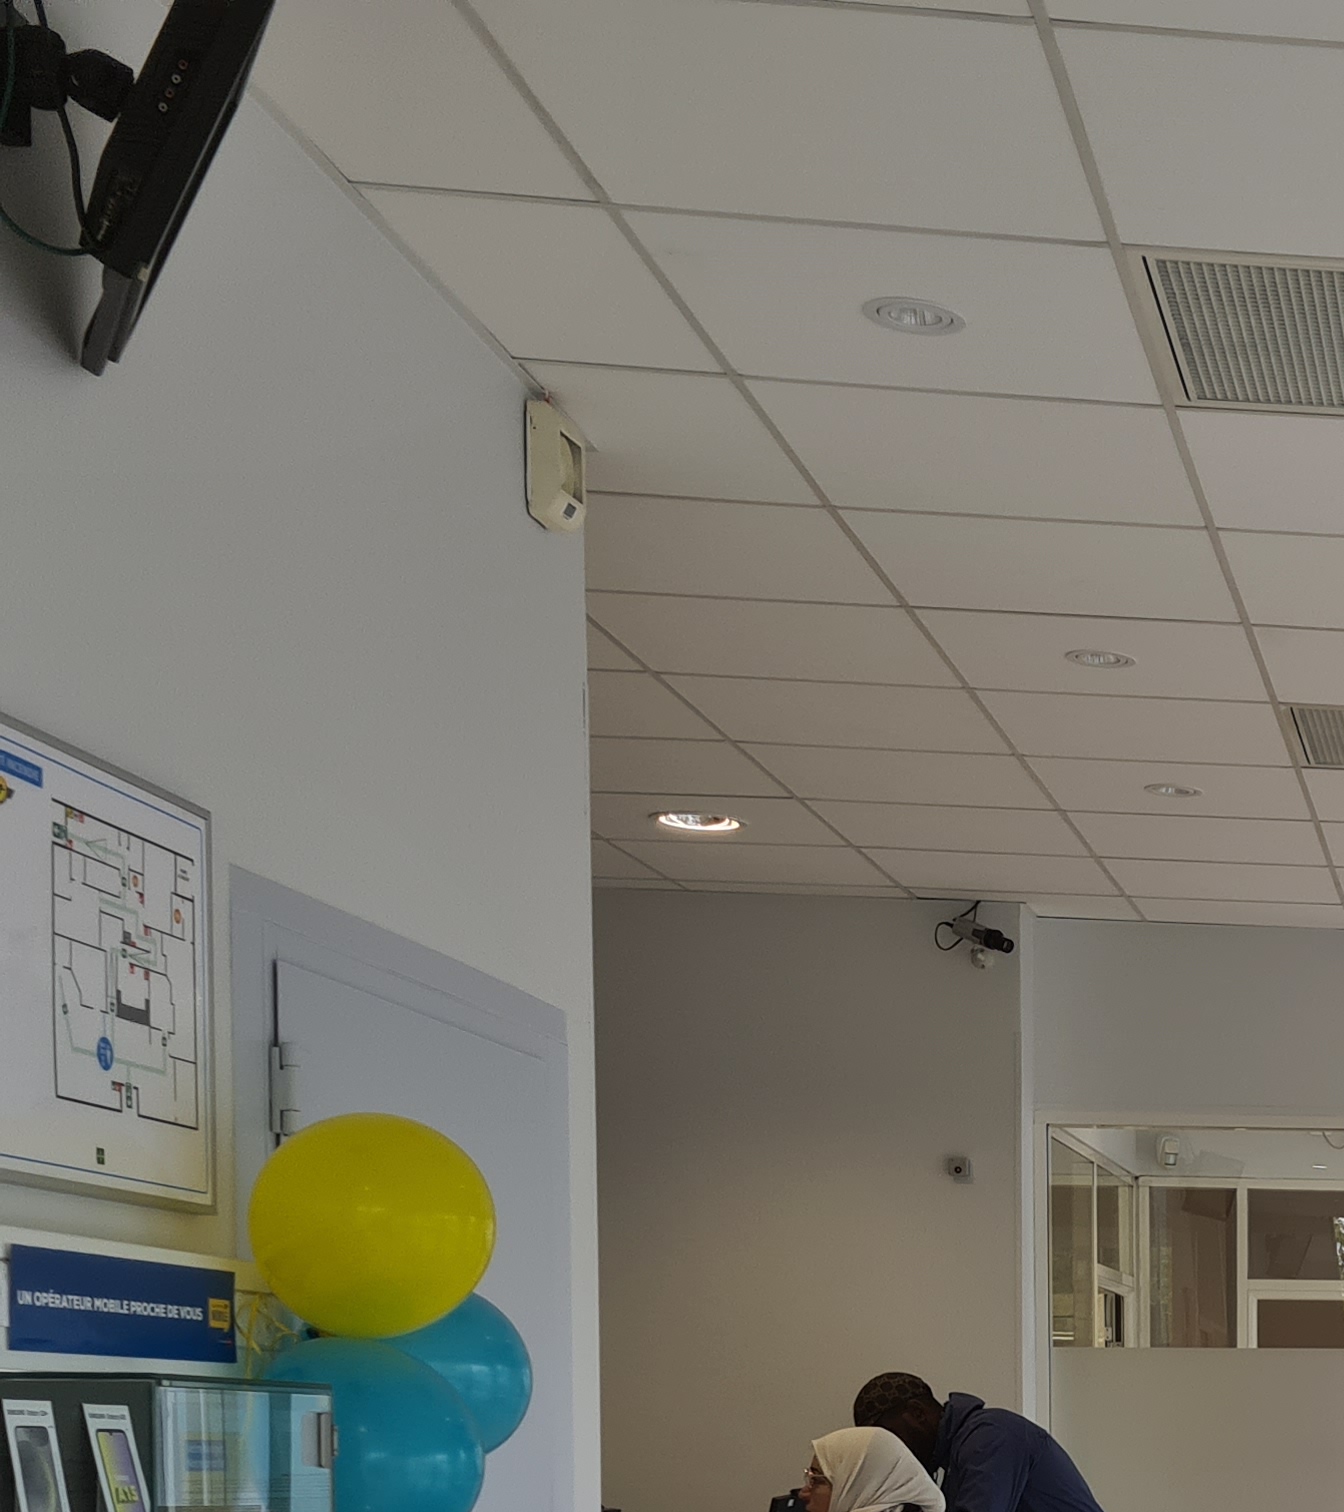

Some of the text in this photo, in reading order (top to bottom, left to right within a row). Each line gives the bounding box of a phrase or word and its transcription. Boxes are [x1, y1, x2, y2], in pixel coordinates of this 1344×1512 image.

[17, 1289, 204, 1321] UN OPÉRATEUR MOBILE PROCHE DE VOUS
